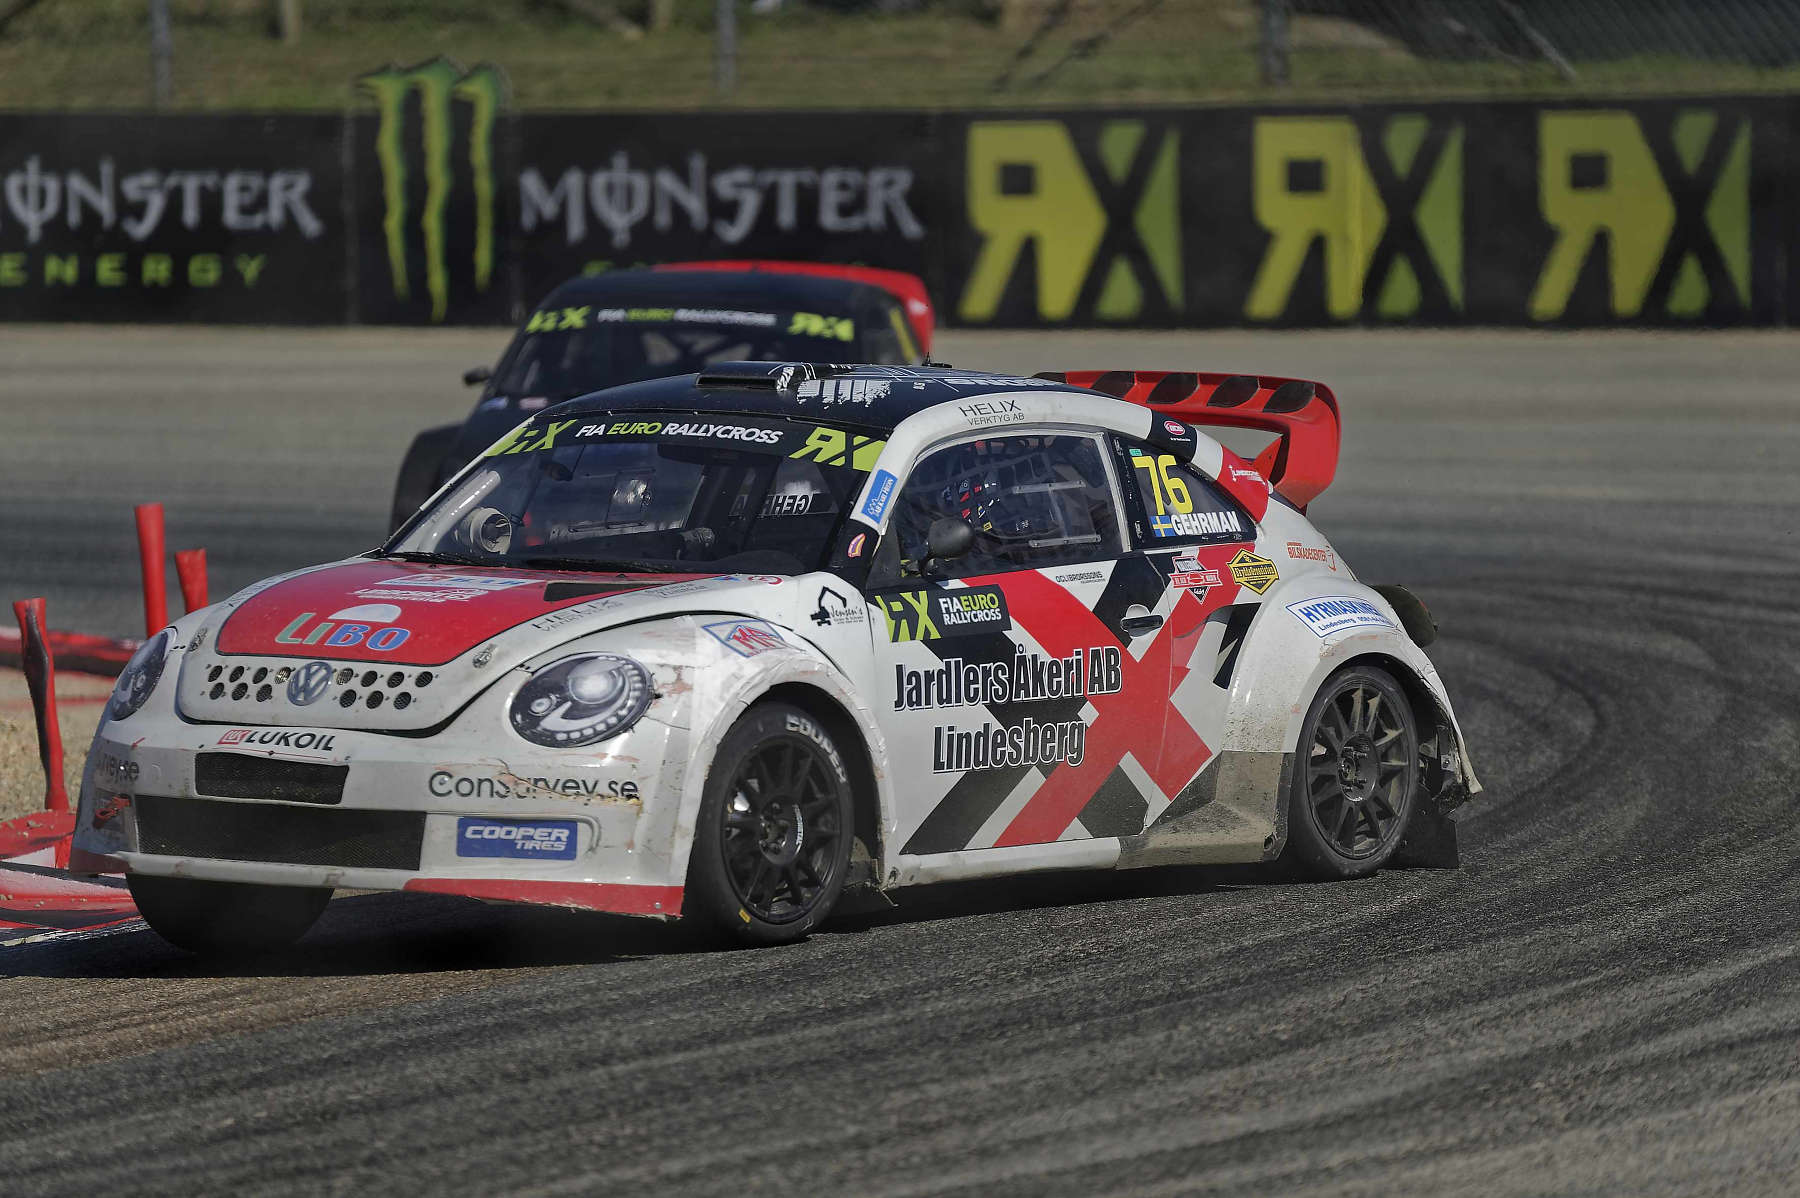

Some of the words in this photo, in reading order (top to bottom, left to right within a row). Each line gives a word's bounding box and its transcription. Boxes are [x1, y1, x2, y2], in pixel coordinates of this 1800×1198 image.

[518, 150, 925, 249] MONSTER
[0, 251, 268, 287] ENERGY
[958, 399, 1021, 417] HELIX
[967, 413, 1011, 426] VERKTYG
[1012, 412, 1025, 421] AB
[575, 423, 606, 439] FIA
[606, 421, 664, 437] EURO
[660, 422, 784, 445] RALLYCROSS
[1131, 454, 1194, 516] 76
[1170, 510, 1242, 536] GEHRMAN
[943, 608, 1002, 626] RALLYCROSS
[274, 612, 411, 652] LIBO
[894, 657, 1009, 712] Jardlers
[1014, 644, 1083, 702] Åkeri
[1087, 645, 1122, 696] AB
[244, 730, 336, 752] LUKOIL
[933, 717, 1086, 774] Lindesberg
[465, 825, 570, 842] COOPER
[514, 839, 567, 852] TIRES
